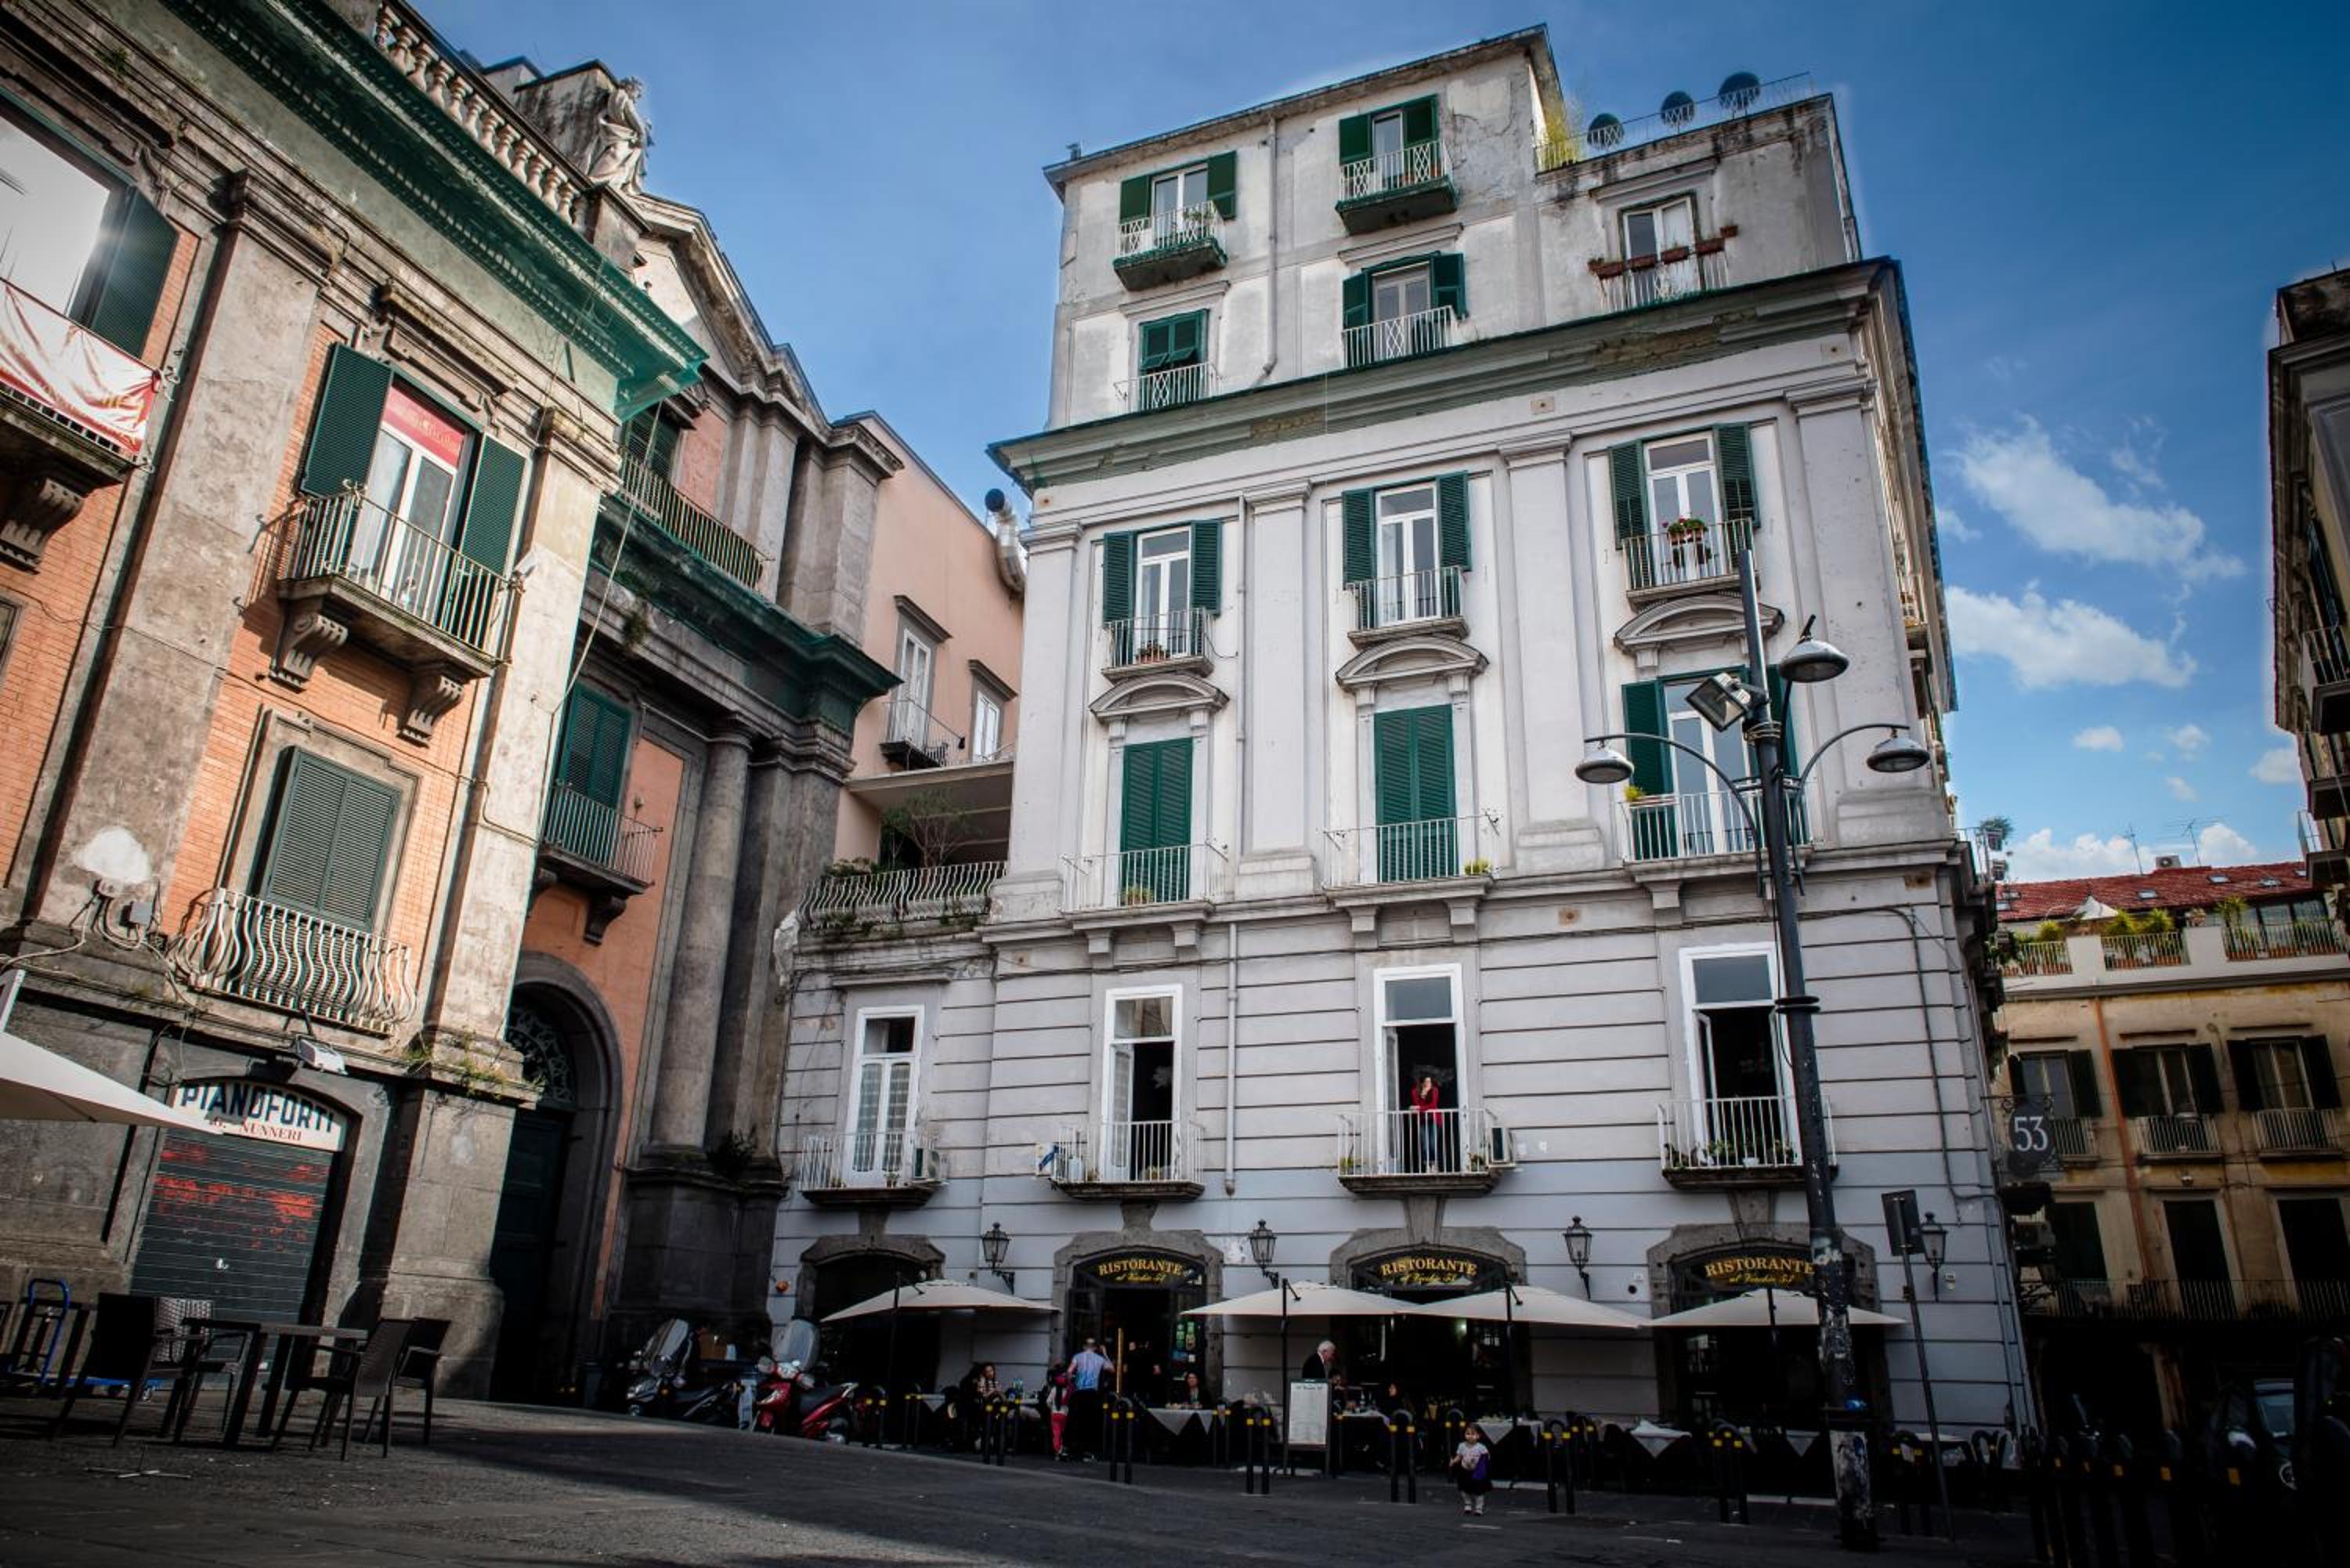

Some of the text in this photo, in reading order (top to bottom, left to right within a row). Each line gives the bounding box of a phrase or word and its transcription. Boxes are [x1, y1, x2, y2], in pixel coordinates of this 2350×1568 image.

[179, 1082, 334, 1133] PIANOFORTI
[240, 1119, 302, 1141] NUNNERI
[2014, 1116, 2048, 1151] 53
[1098, 1258, 1184, 1276] RISTORANTE
[1380, 1257, 1478, 1276] RISTORANTE
[1704, 1256, 1815, 1277] RISTORANTE
